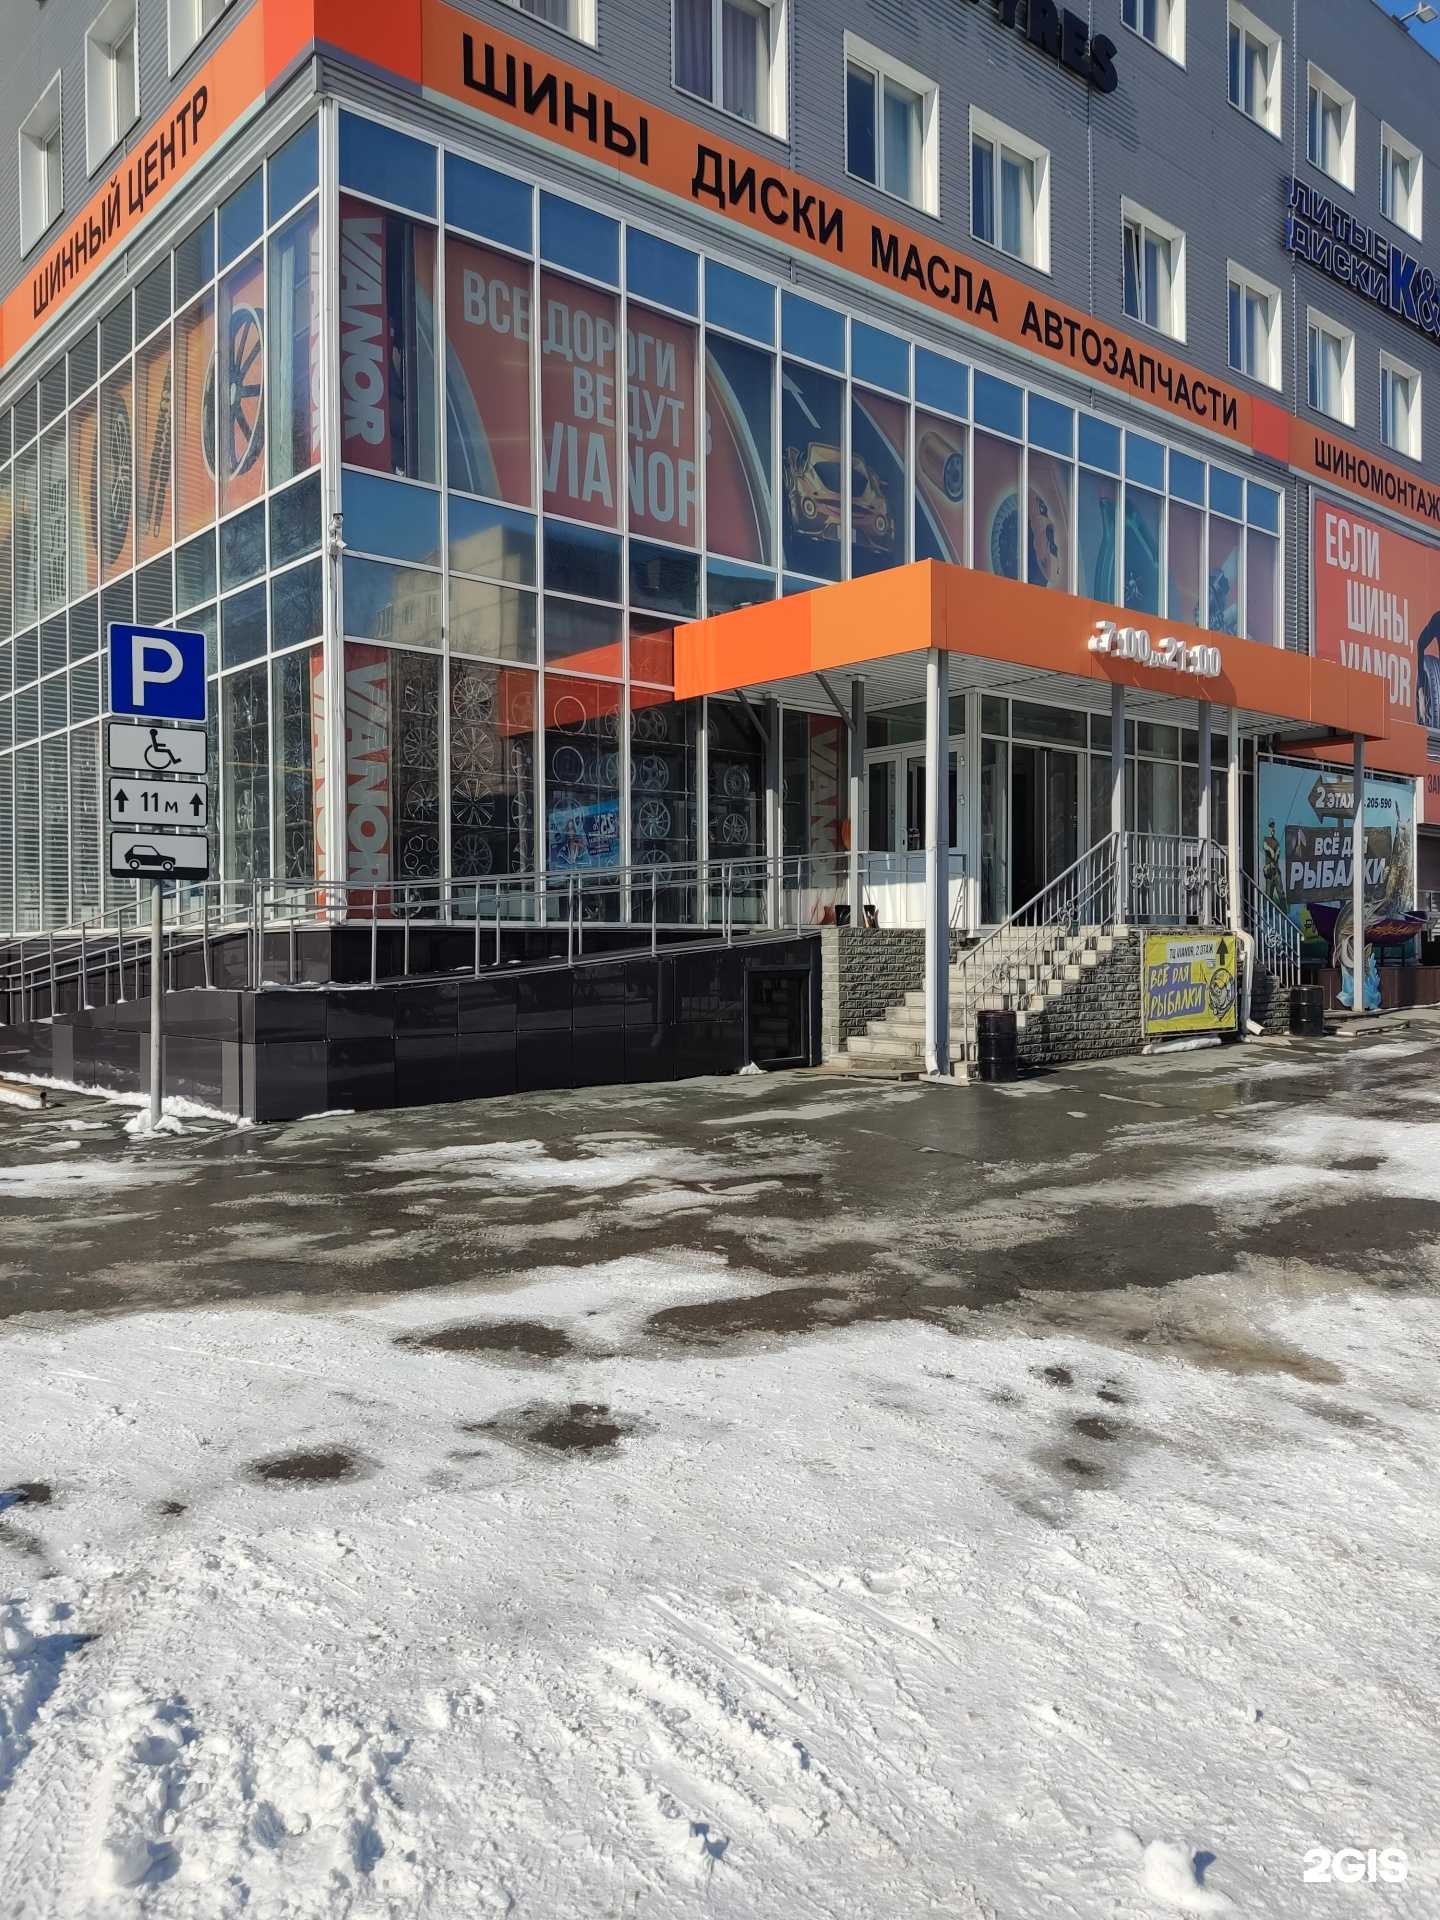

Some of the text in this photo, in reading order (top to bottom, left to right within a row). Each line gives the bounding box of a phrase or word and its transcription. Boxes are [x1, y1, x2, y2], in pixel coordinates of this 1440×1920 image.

[967, 0, 1118, 93] RES
[33, 85, 207, 319] ШИННЫЙ ЦЕНТР
[462, 32, 1238, 430] ШИНЫ ДИСКИ МАСЛА АВТОЗАПЧАСТИ
[1291, 176, 1389, 268] ЛИТЫЕ
[1290, 217, 1388, 306] ДИСКИ
[341, 217, 385, 445] VIANOR
[463, 268, 676, 392] ВСЕ ДОРОГИ
[573, 366, 685, 448] ВЕДУТ
[1314, 437, 1440, 524] ШИНОМОНТАЖ
[1325, 512, 1380, 581] ЕСЛИ
[1346, 579, 1415, 655] ШИНЫ,
[132, 635, 184, 707] P
[140, 791, 160, 813] 11
[1315, 786, 1326, 809] 2
[1314, 832, 1340, 856] ВСЁ
[1150, 985, 1202, 1019] РЫБАЛКИ
